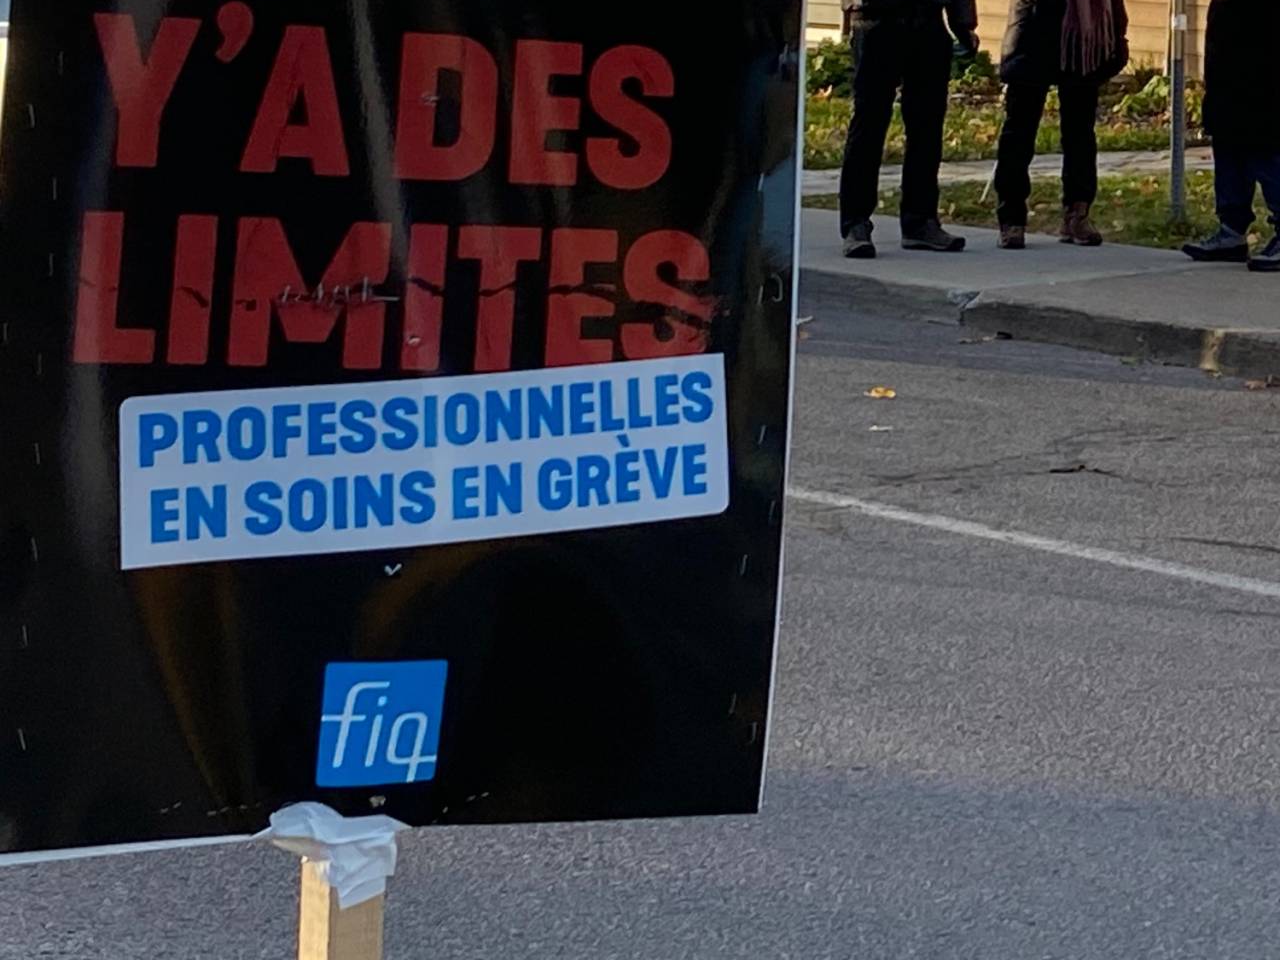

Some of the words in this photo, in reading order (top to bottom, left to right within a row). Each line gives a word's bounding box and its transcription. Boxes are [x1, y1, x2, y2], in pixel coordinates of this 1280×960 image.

[94, 1, 350, 176] Y'A
[392, 32, 675, 190] DES
[72, 211, 713, 371] LIMITES
[138, 372, 714, 468] PROFESSIONNELLES
[149, 486, 228, 545] EN
[244, 470, 436, 536] SOINS
[452, 463, 523, 518] EN
[537, 435, 708, 511] GRÈVE
[320, 681, 438, 783] fiq
